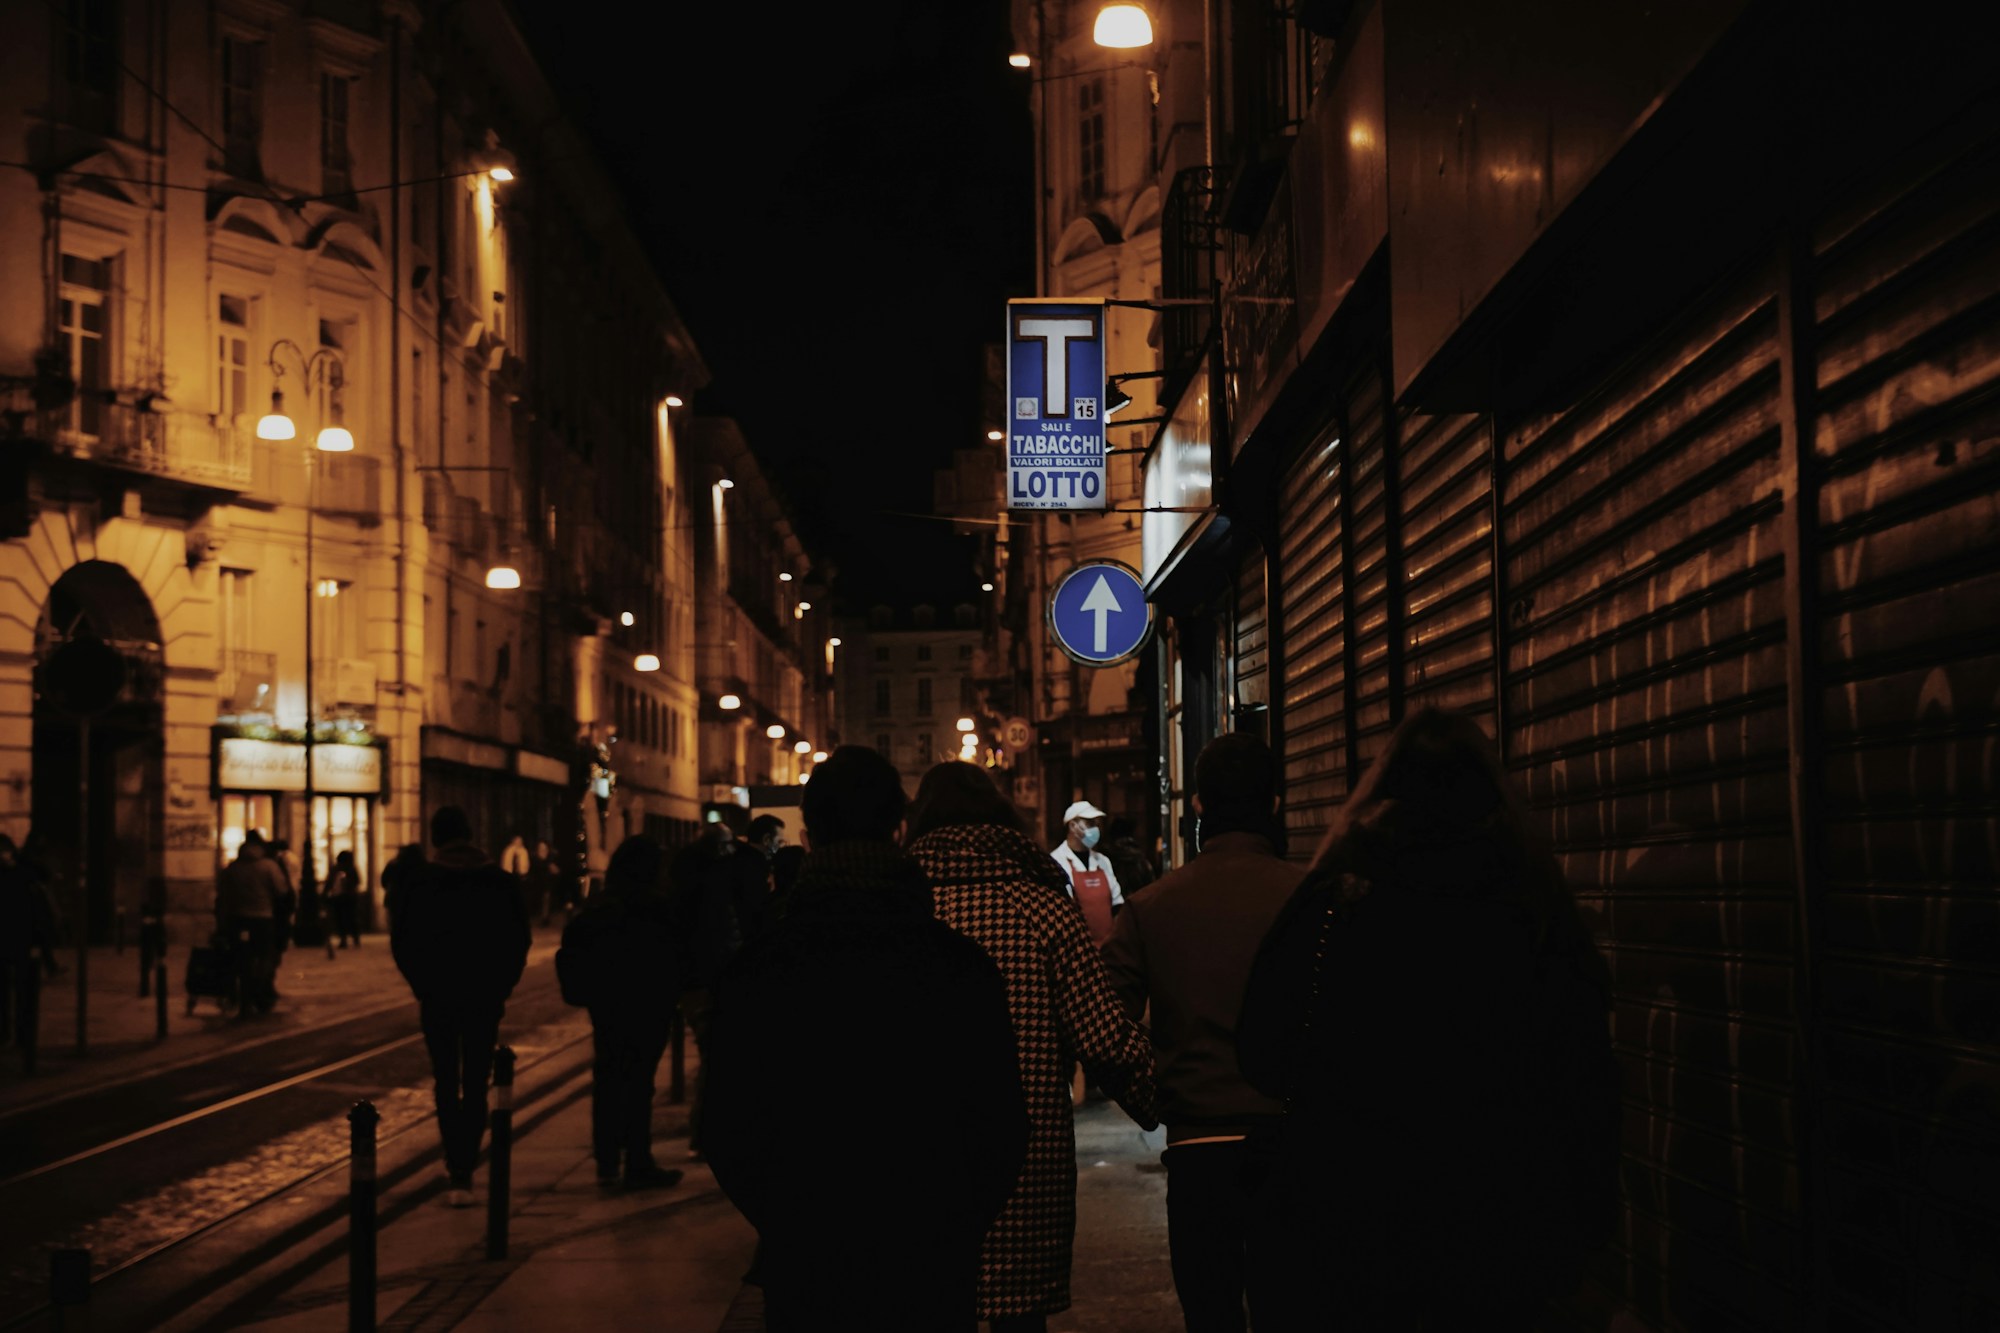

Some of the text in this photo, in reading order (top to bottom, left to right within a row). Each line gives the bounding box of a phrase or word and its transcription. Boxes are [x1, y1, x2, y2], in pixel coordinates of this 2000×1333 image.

[1019, 319, 1094, 415] T
[1077, 405, 1094, 417] 15
[1041, 423, 1072, 432] SALI E
[1013, 435, 1100, 454] TABACCHI
[1014, 458, 1100, 466] VALORI BOLLATI
[1013, 471, 1100, 498] LOTTO
[1011, 728, 1026, 742] 30
